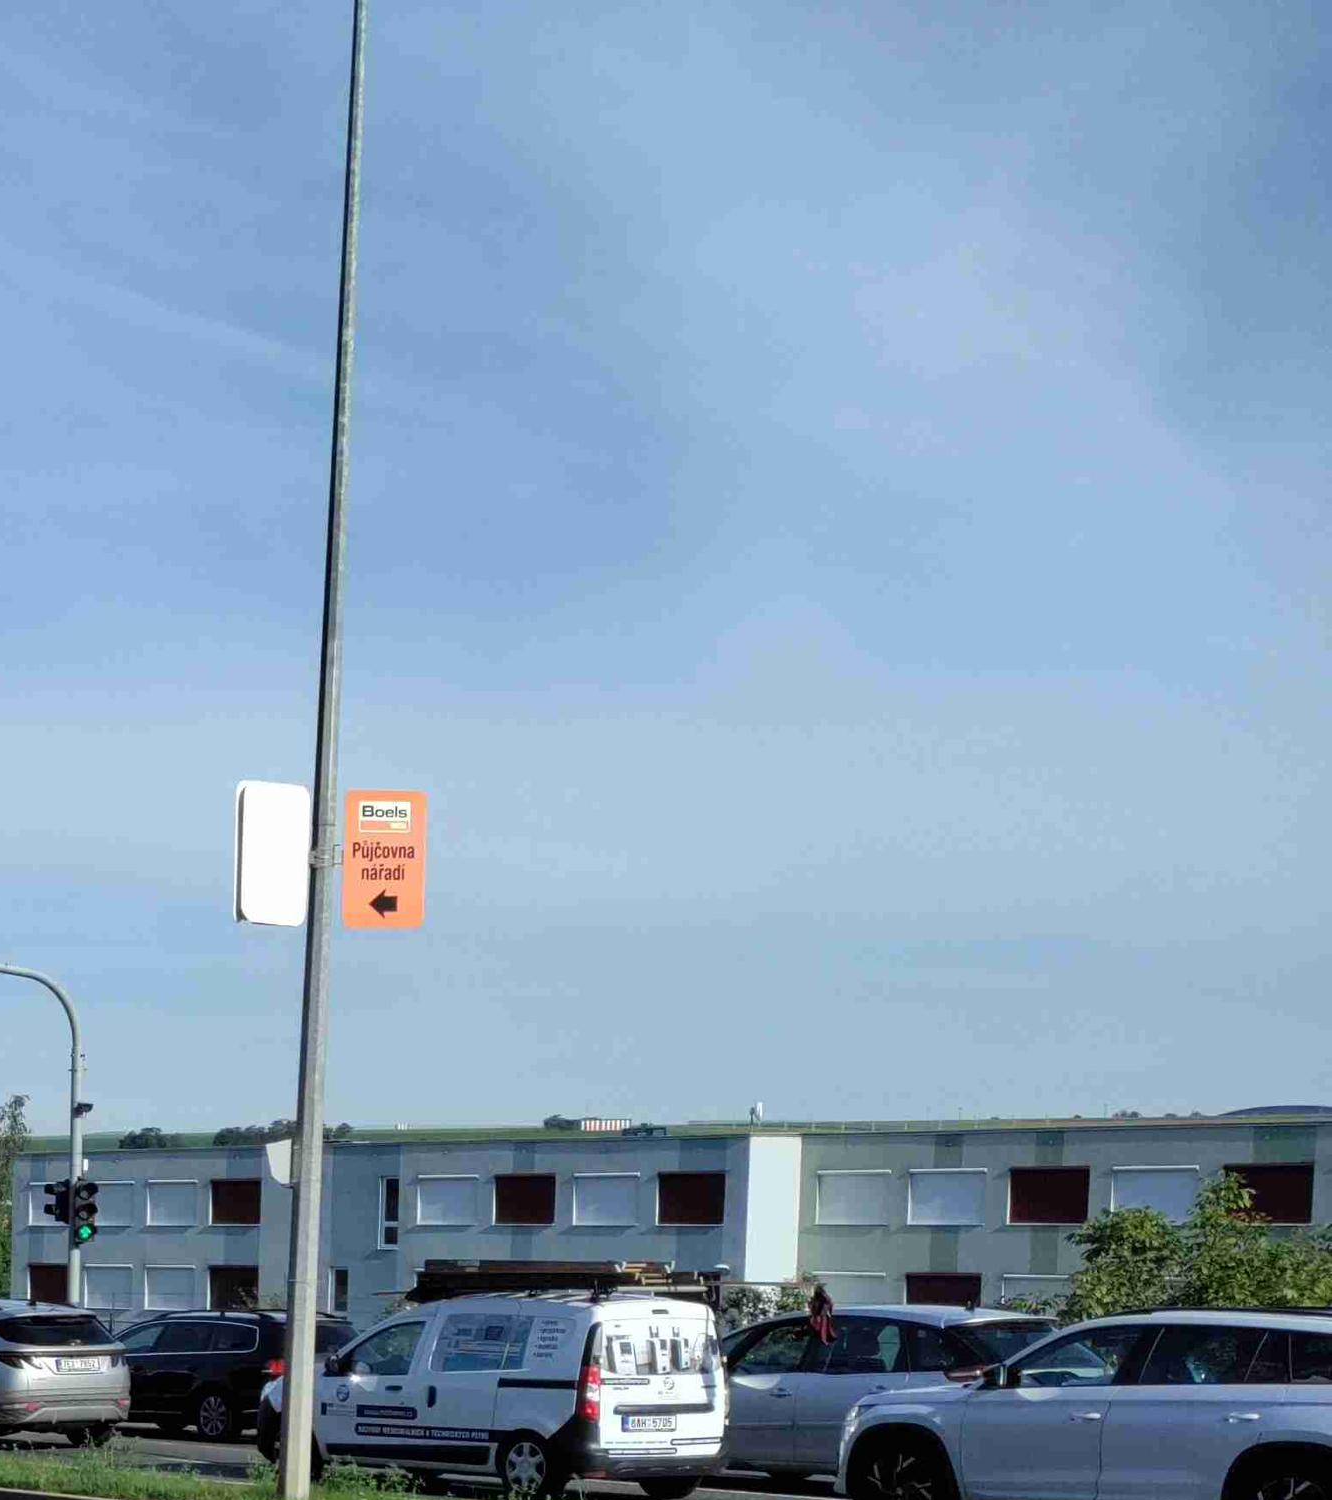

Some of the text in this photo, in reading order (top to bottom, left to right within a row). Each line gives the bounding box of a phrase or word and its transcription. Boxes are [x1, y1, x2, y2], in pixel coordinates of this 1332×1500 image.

[362, 804, 408, 818] Boels
[352, 841, 415, 861] Půjčovna
[361, 863, 406, 881] nářadí
